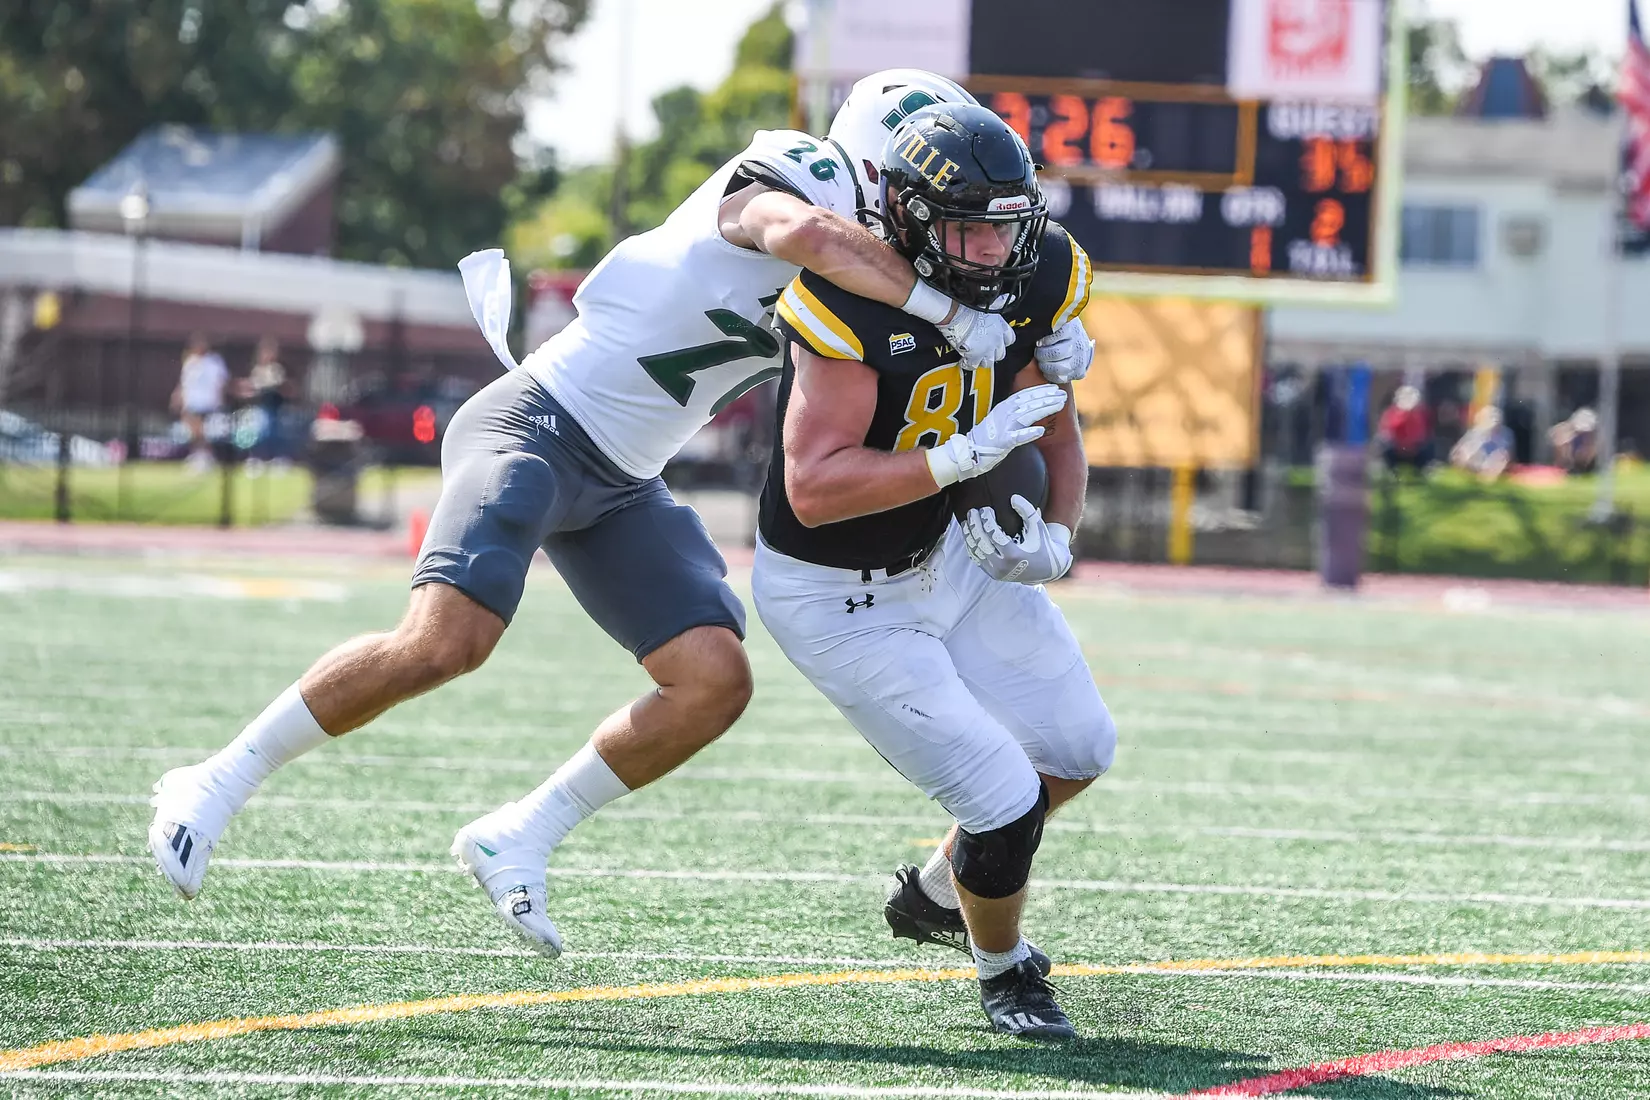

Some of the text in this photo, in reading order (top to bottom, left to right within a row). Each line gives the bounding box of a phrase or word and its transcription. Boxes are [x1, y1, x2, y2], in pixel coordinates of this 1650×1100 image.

[783, 140, 840, 187] 26
[892, 128, 960, 191] VILLE
[891, 338, 914, 349] PSAC
[892, 361, 995, 453] 81
[528, 415, 560, 436] adidas
[930, 931, 972, 954] adida
